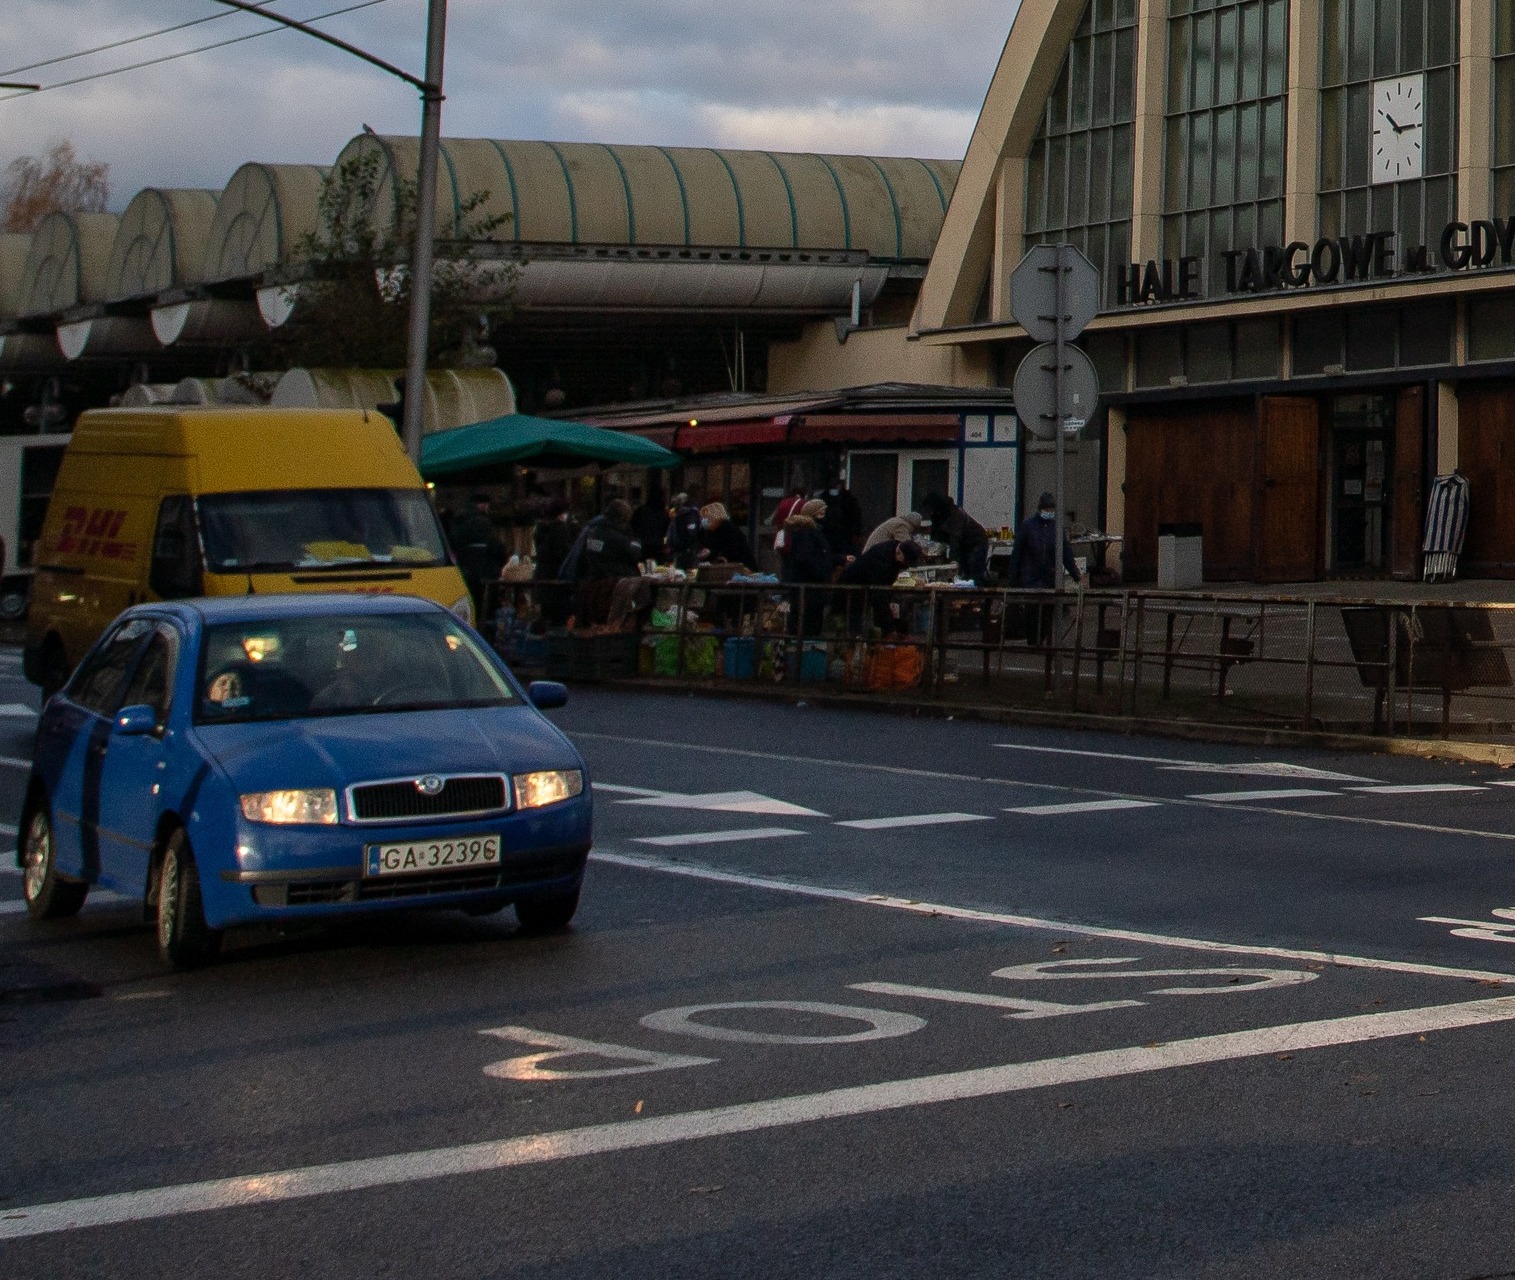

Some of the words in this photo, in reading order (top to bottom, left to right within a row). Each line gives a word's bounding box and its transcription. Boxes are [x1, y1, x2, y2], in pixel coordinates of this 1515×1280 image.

[1117, 256, 1200, 305] HALE
[1221, 231, 1395, 292] TARGOWE
[384, 847, 417, 869] GA
[428, 839, 496, 866] 32396
[478, 957, 1320, 1080] STOP
